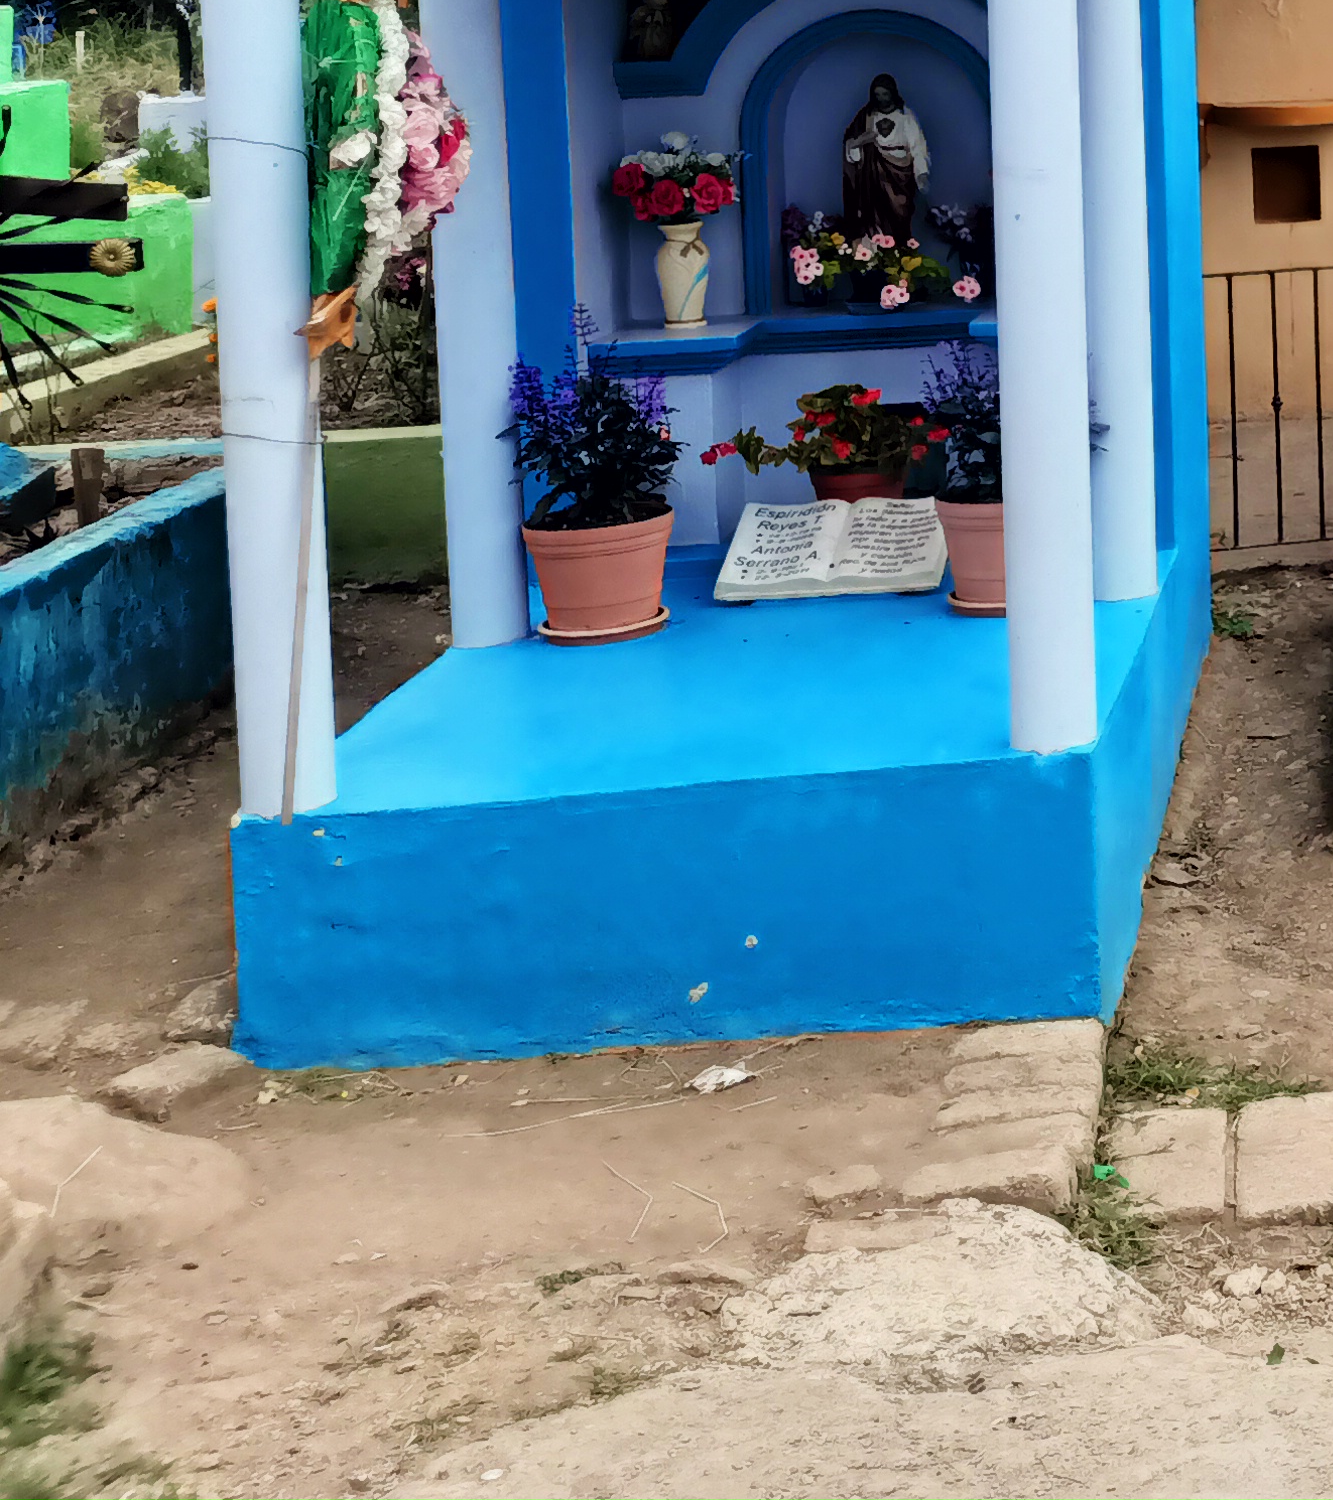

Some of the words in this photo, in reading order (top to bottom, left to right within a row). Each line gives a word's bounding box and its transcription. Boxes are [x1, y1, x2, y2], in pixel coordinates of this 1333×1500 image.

[757, 520, 808, 533] Reyes
[751, 541, 813, 555] Antonia
[734, 555, 800, 568] Serrano
